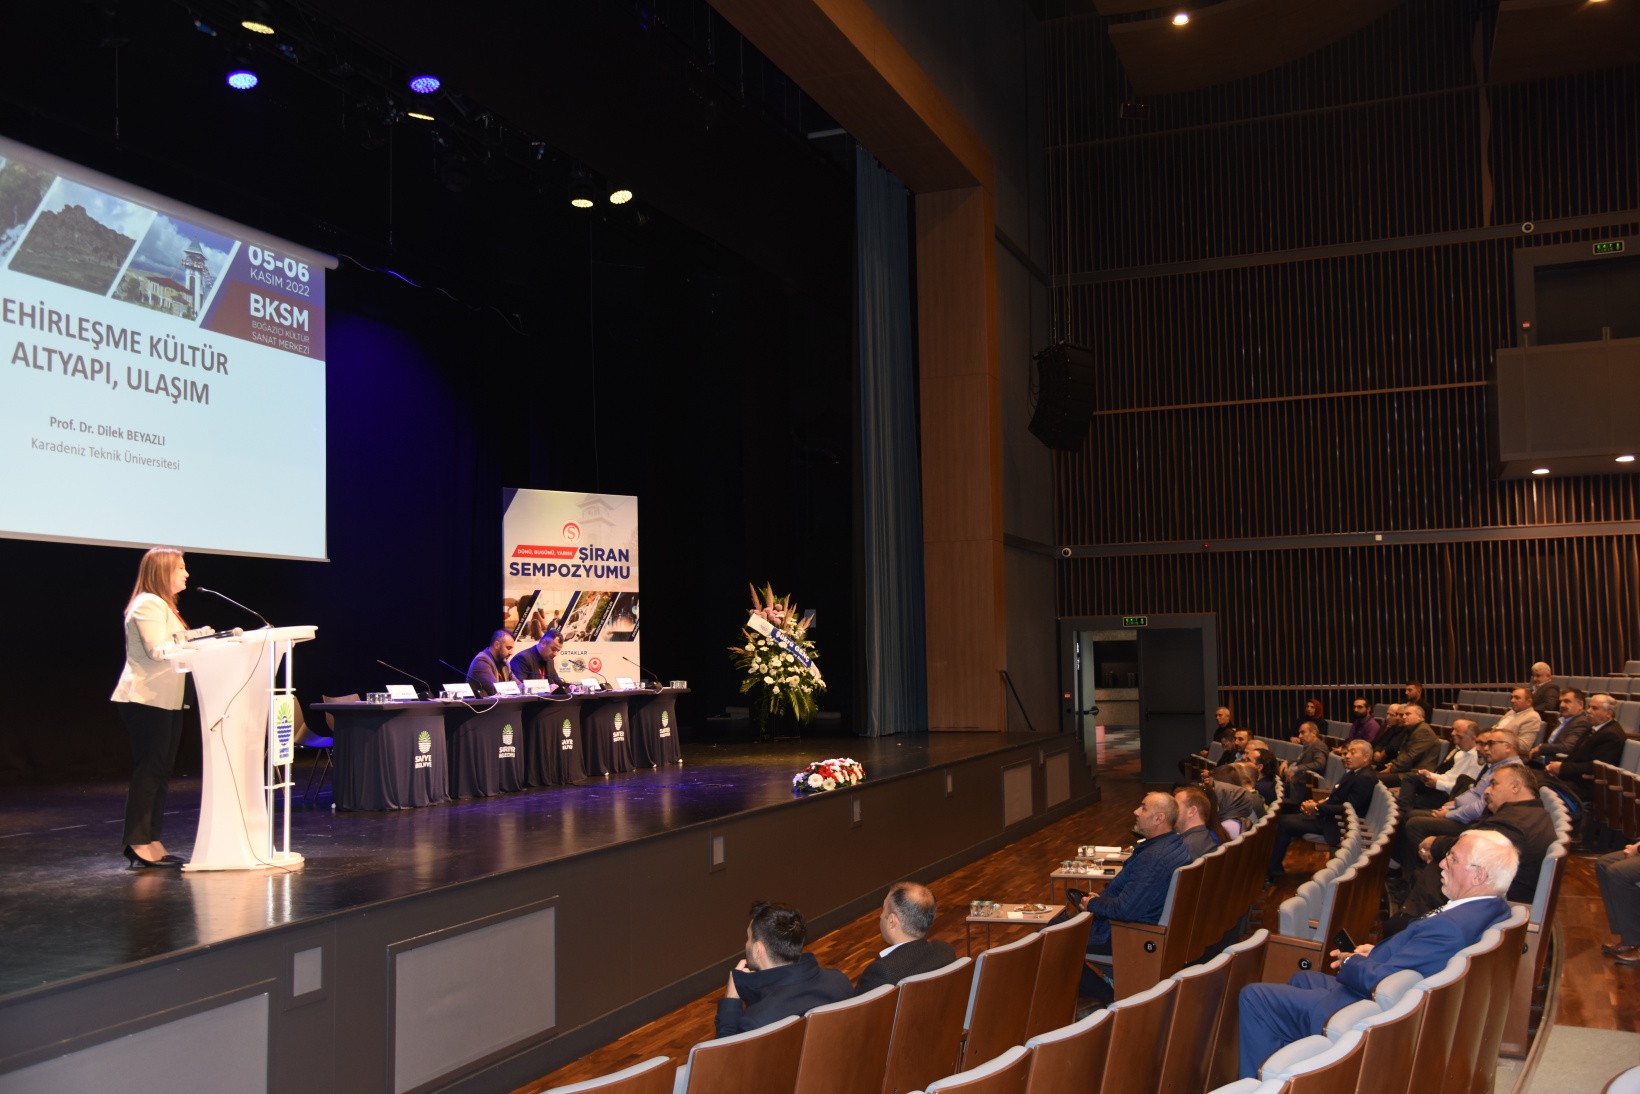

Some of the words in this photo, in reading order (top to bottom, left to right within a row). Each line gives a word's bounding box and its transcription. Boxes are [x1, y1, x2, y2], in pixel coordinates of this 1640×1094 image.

[248, 245, 310, 282] 05-06
[250, 267, 283, 288] KASIM
[286, 280, 310, 297] 2022
[250, 292, 308, 332] BKSM
[0, 297, 141, 355] EHİRLEŞME
[149, 334, 228, 375] KÜLTÜR
[252, 320, 284, 336] BOĞAZİÇİ
[285, 328, 310, 344] KÜLTÜR
[252, 331, 276, 346] SANAT
[278, 339, 310, 355] MERKEZİ
[11, 340, 118, 390] ALTYAPI,
[126, 366, 210, 404] ULAŞIM
[50, 416, 76, 432] Prof.
[79, 421, 94, 434] Dr.
[97, 424, 124, 440] Dilek
[126, 430, 166, 446] BEYAZLI
[31, 437, 86, 456] Karadeniz
[88, 446, 122, 462] Teknik
[124, 451, 180, 470] Üniversitesi
[578, 544, 630, 563] ŞİRAN
[509, 562, 630, 580] SEMPOZYUMU
